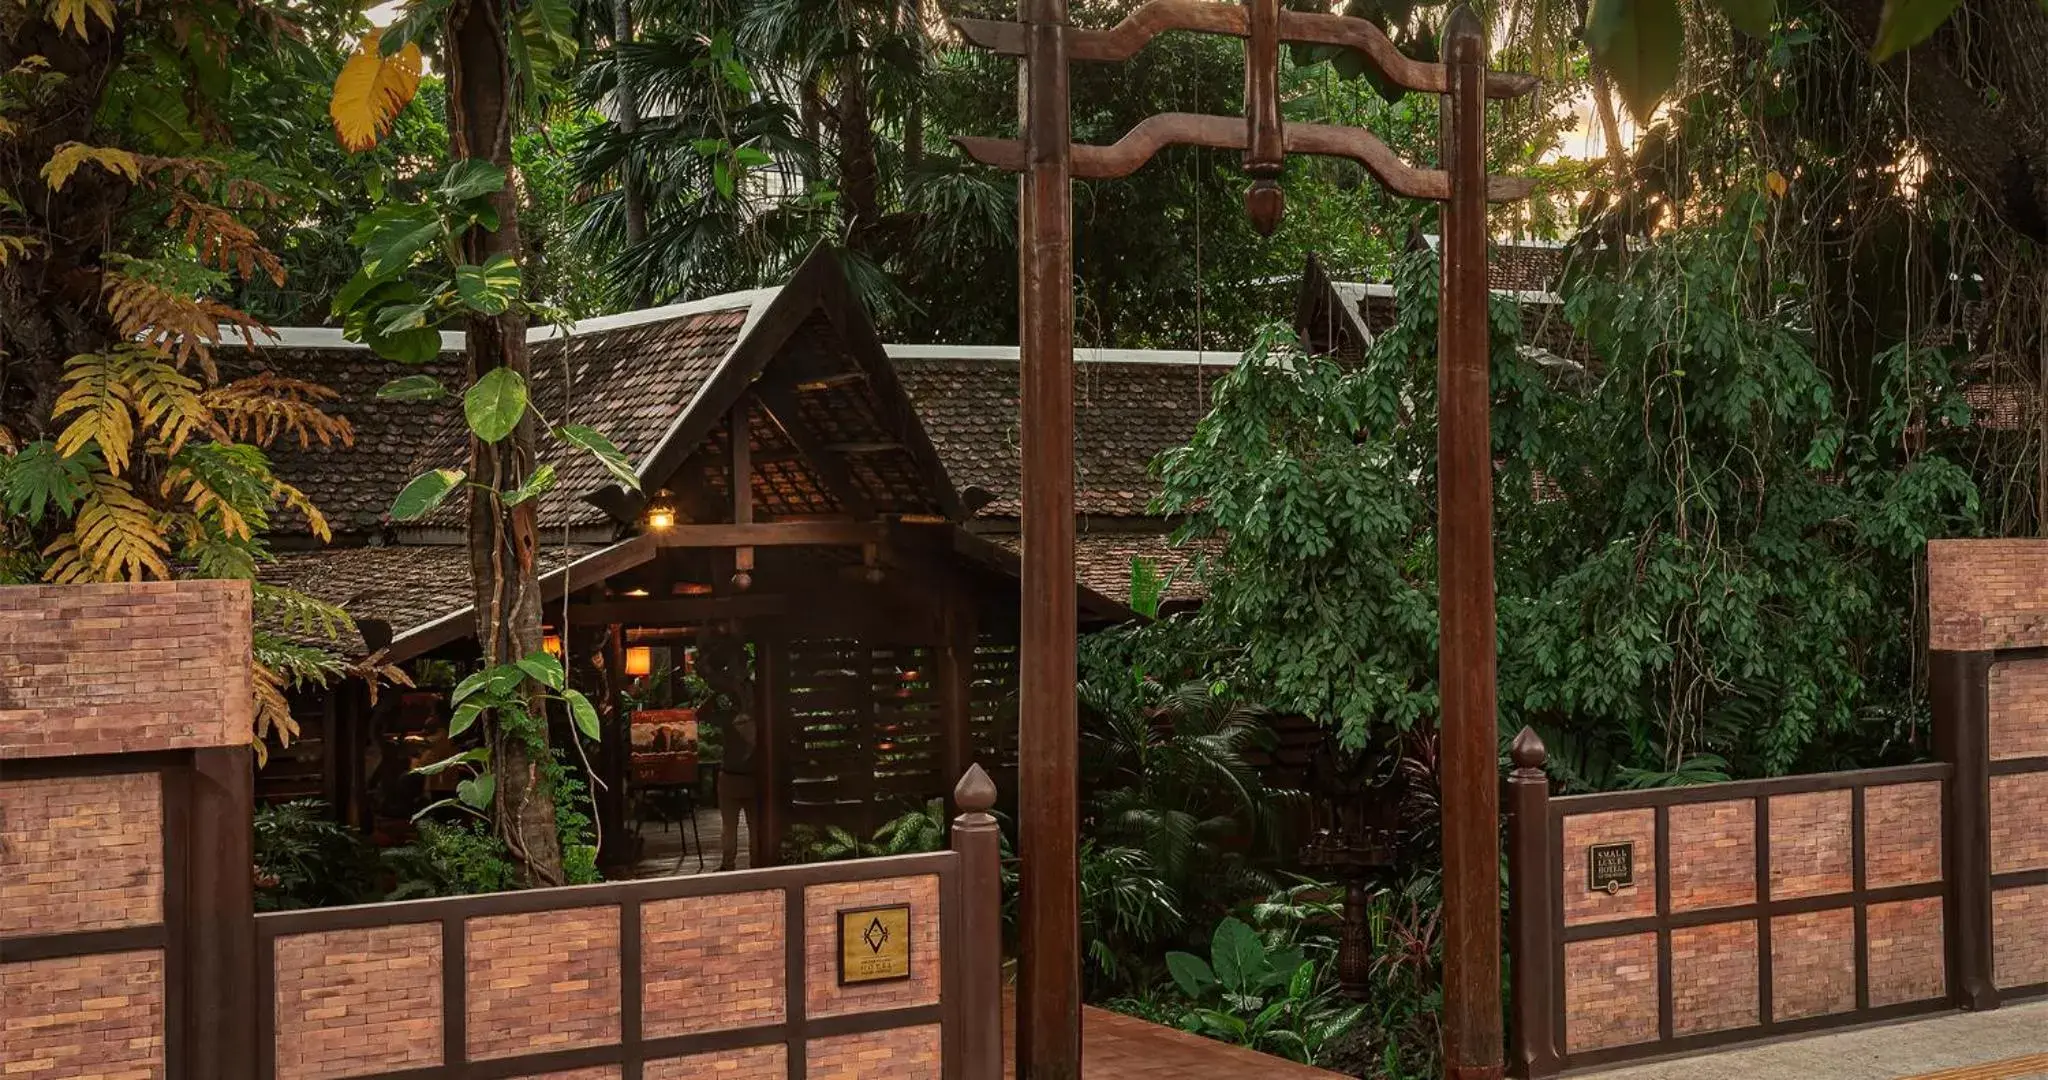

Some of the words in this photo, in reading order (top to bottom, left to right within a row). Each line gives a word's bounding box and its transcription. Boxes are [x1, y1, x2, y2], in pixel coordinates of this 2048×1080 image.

[1598, 848, 1627, 857] SMALL
[1598, 857, 1626, 866] LUXURY
[1598, 865, 1627, 874] HOTELS
